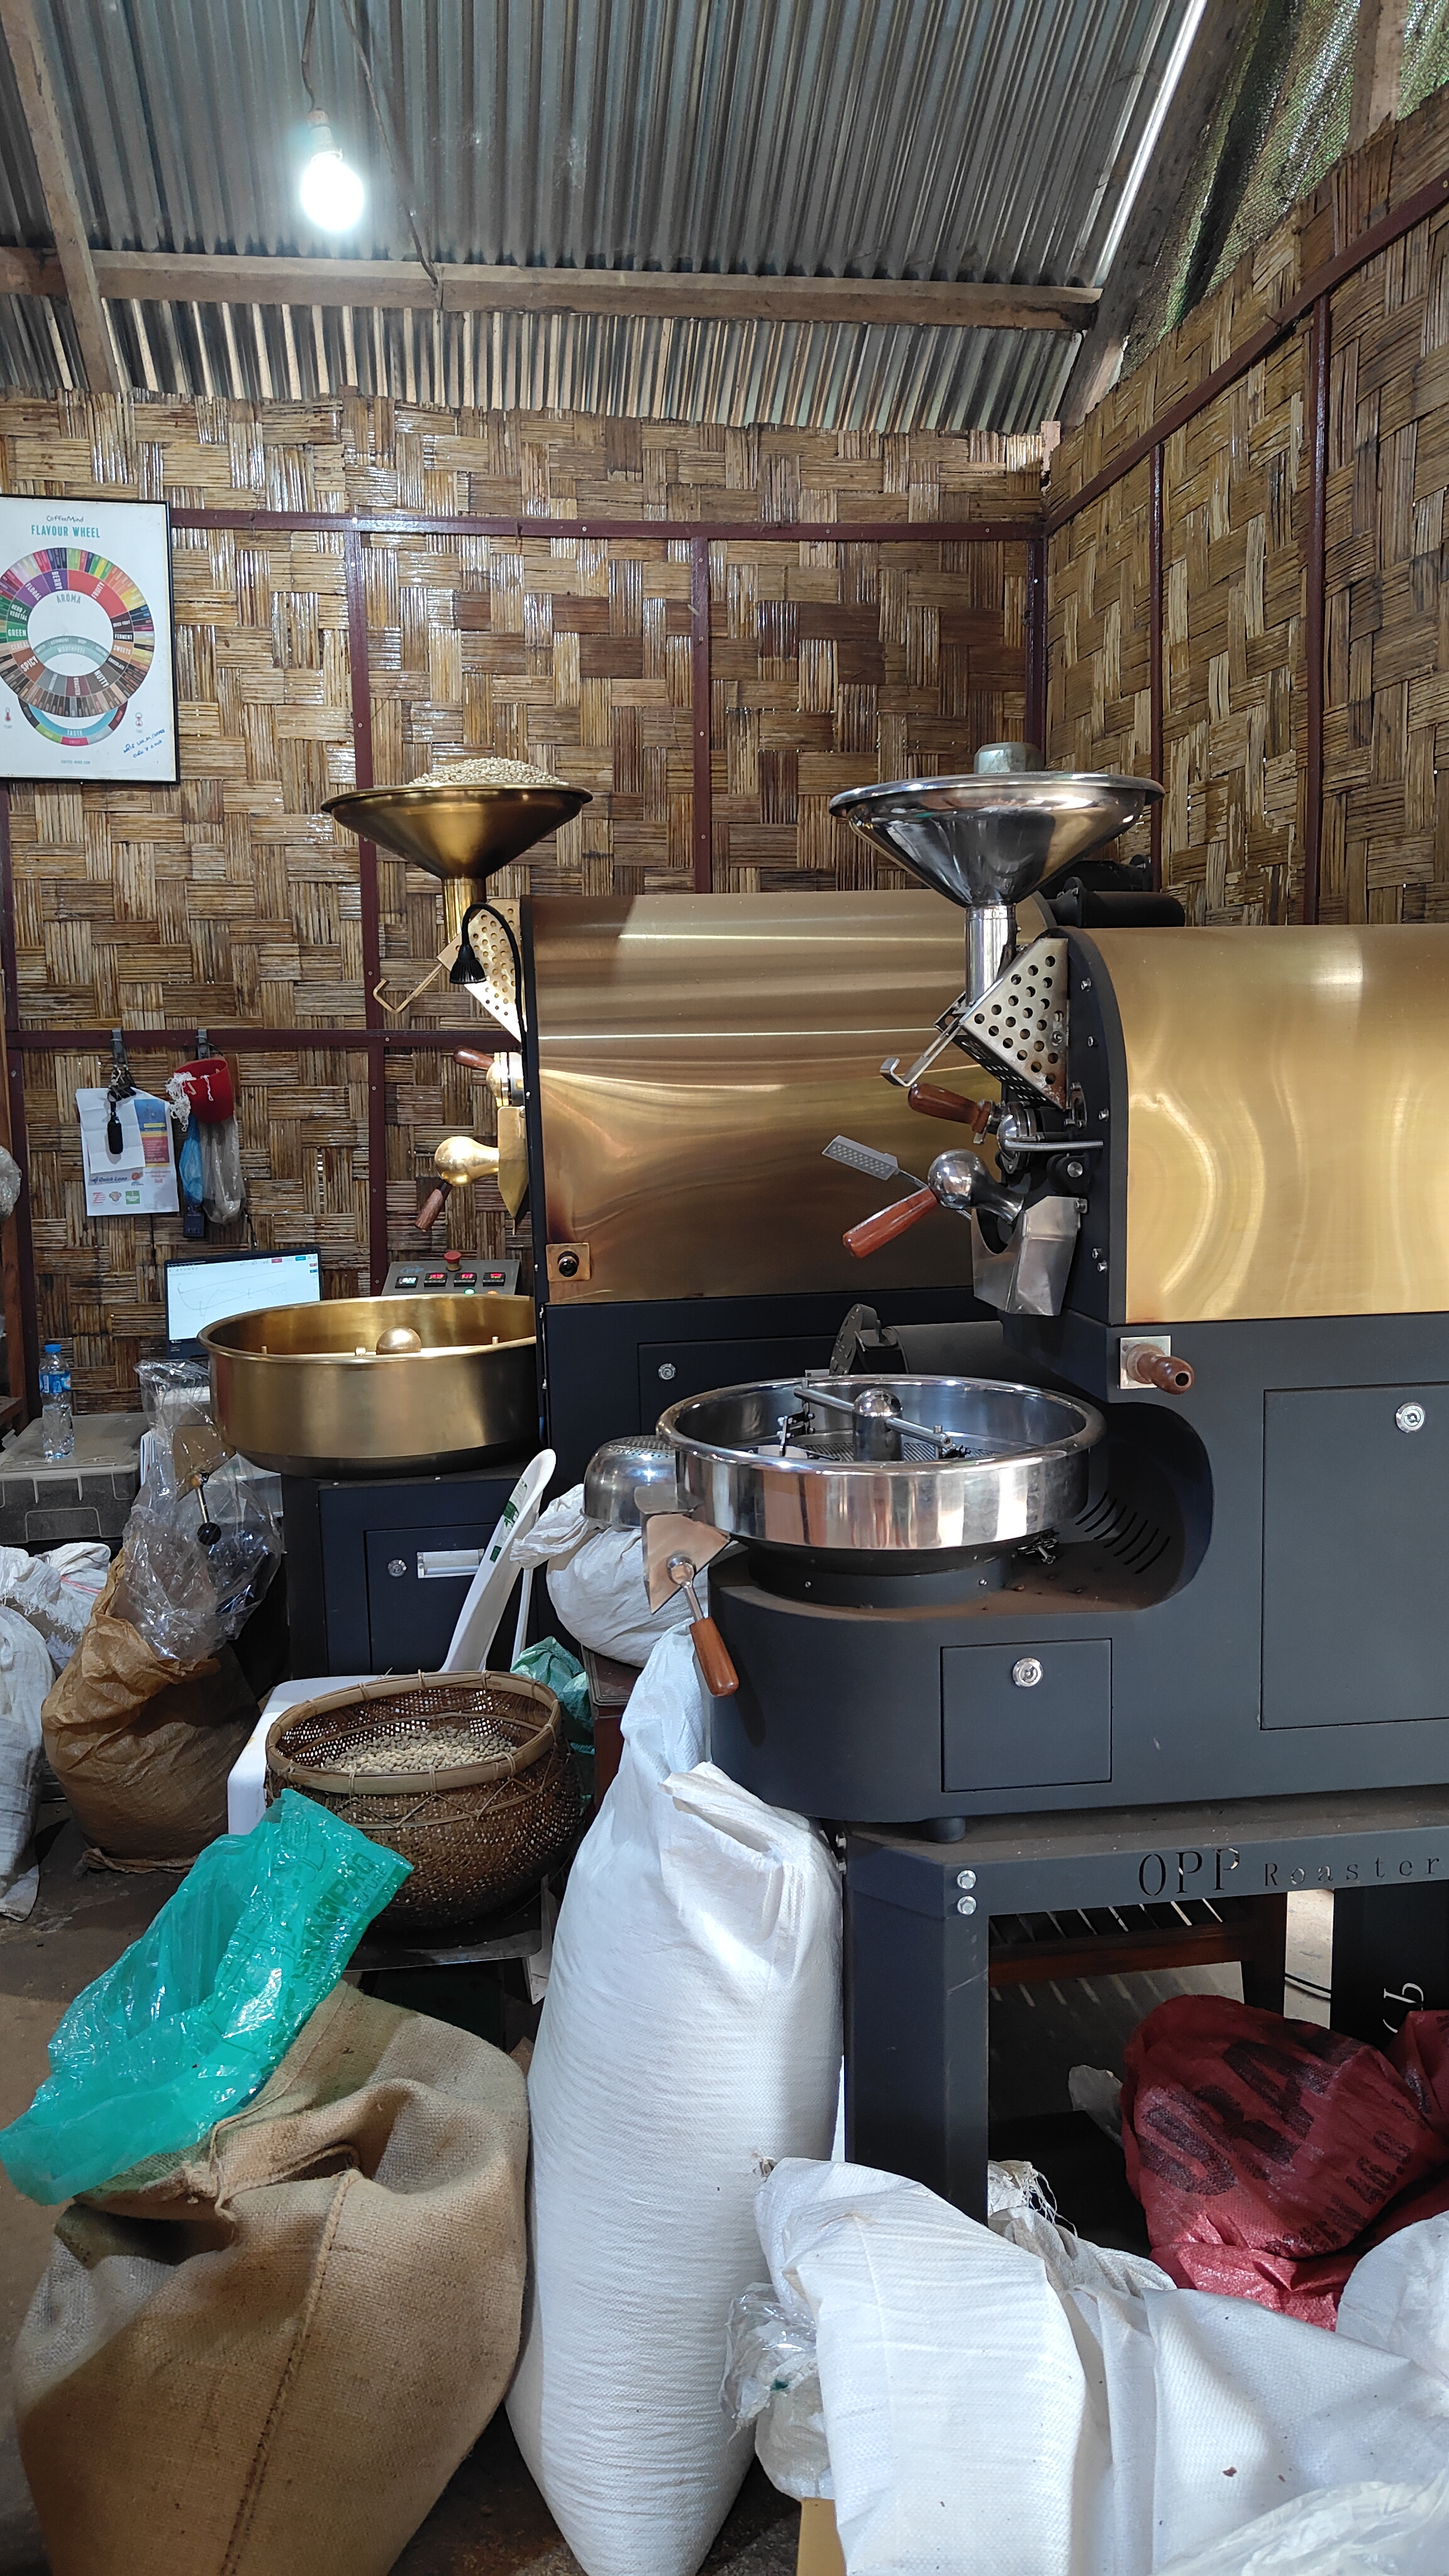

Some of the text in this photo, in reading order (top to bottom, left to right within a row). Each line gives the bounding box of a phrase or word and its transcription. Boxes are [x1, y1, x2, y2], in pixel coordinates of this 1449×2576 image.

[31, 525, 101, 538] FLAVOUR WHEEL
[51, 570, 63, 590] BERRY
[25, 582, 42, 601] FLORAL
[56, 593, 82, 604] AROMA
[91, 581, 106, 599] FRUITY
[8, 629, 27, 637] GREEN
[10, 641, 30, 651] CEREAL
[113, 645, 131, 655] SWEETS
[20, 655, 39, 673] SPICY
[94, 669, 110, 688] NUTTY
[1138, 1846, 1440, 1897] OPP Roaster
[354, 1867, 389, 1909] FUTURE
